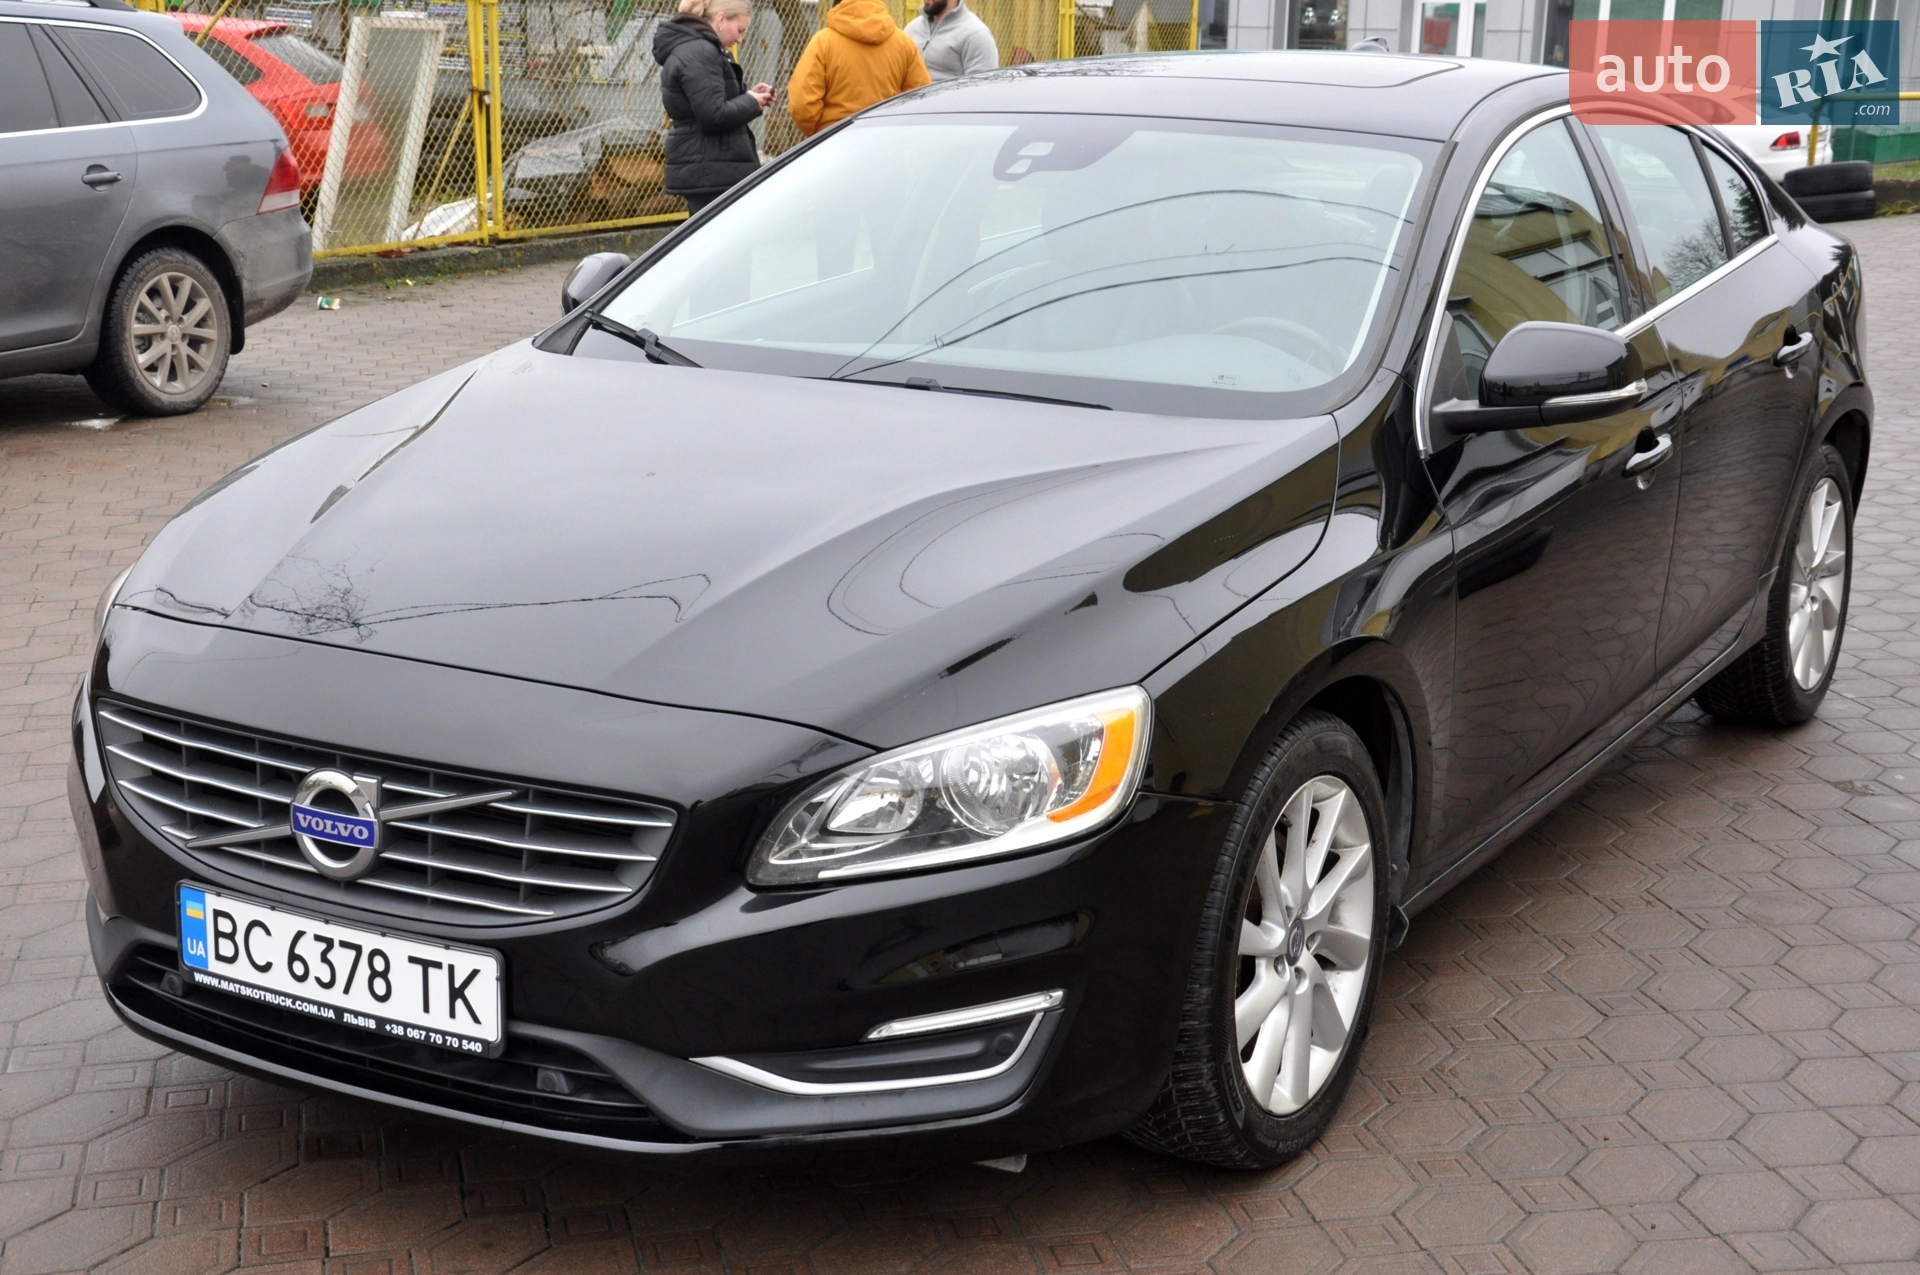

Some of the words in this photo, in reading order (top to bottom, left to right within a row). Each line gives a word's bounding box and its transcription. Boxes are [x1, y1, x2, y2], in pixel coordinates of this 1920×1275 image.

[295, 812, 369, 840] VOLVO
[187, 937, 206, 958] UA
[212, 908, 273, 973] BC
[287, 929, 393, 1003] 6378
[407, 955, 482, 1024] TK
[193, 971, 336, 1019] WWW.MATSKOTRUCK.COM.UA
[384, 1023, 405, 1036] +38
[407, 1027, 427, 1041] 067
[429, 1032, 443, 1044] 70
[445, 1036, 459, 1048] 70
[461, 1040, 483, 1053] 540
